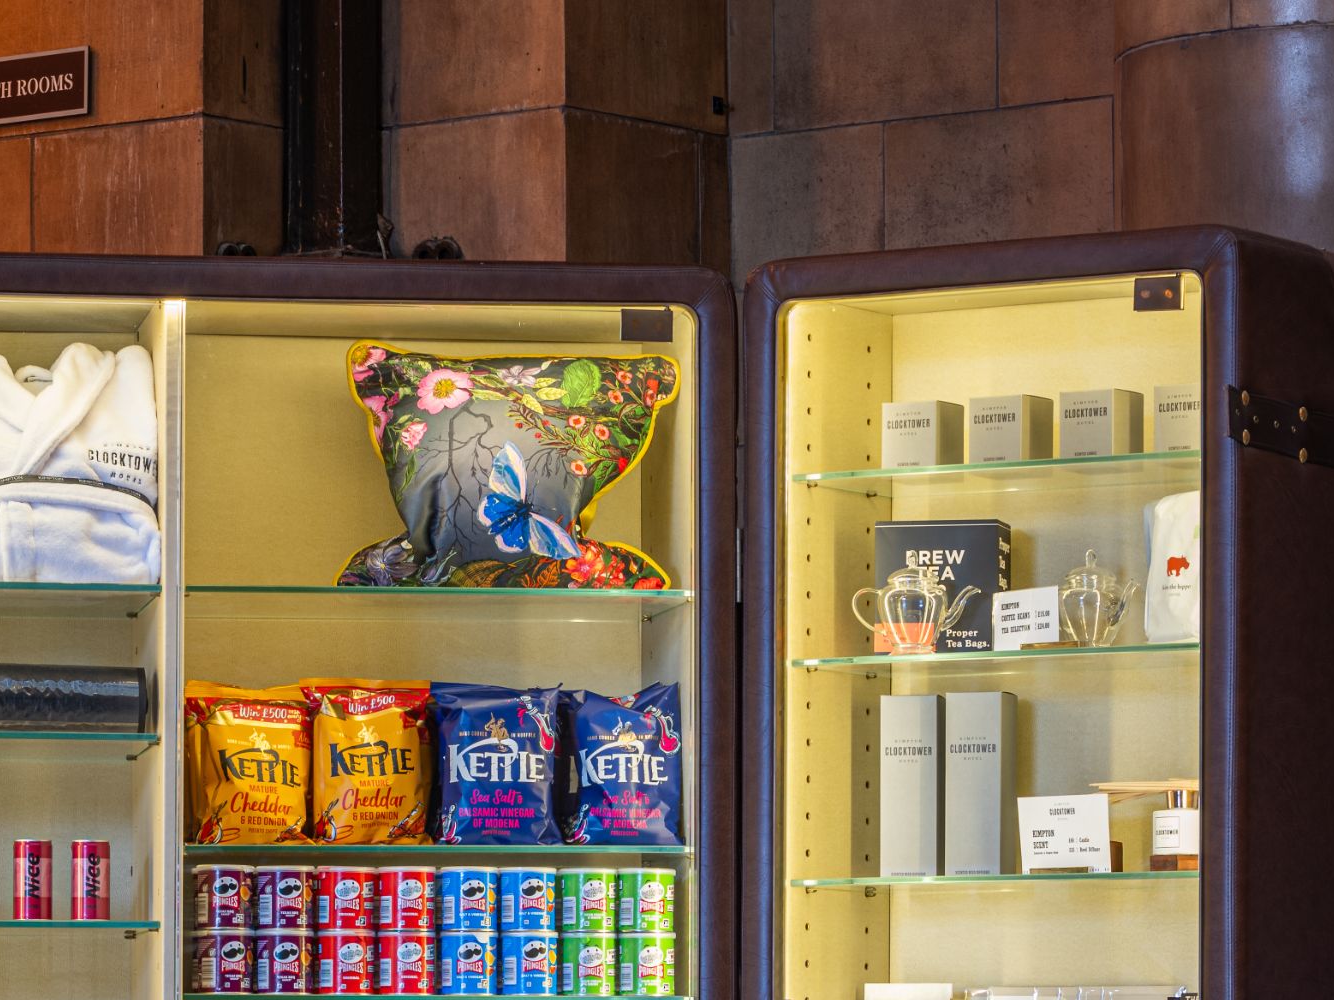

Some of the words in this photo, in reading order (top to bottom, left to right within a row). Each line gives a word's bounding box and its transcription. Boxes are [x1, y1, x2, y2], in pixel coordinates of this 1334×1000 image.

[17, 73, 74, 95] ROOMS
[973, 412, 1016, 425] CLOCKTOWER
[1064, 406, 1108, 419] CLOCKTOWER
[886, 418, 931, 430] CLOCKTOWER
[906, 549, 966, 565] BREW
[917, 566, 955, 581] TEA
[1001, 601, 1020, 611] KIMPTON
[1001, 613, 1016, 622] COFFEE
[1017, 612, 1031, 621] BEANS
[946, 629, 979, 639] Proper
[1010, 625, 1031, 633] SELECTION
[946, 639, 963, 648] Tea
[965, 639, 990, 650] Bags.
[348, 701, 369, 714] Win
[370, 695, 396, 709] £500
[239, 705, 261, 718] Win
[261, 708, 287, 719] £500
[885, 746, 933, 756] CLOCKTOWER
[950, 743, 997, 753] CLOCKTOWER
[329, 740, 415, 778] KETTLE
[448, 737, 545, 784] KETTLE
[578, 739, 669, 788] KETTLE
[218, 747, 301, 788] KETTLE
[249, 784, 278, 795] MATURE
[359, 779, 390, 788] MATURE
[341, 787, 407, 811] Cheddar
[470, 789, 490, 804] Sea
[492, 788, 515, 806] Salt
[602, 789, 618, 804] Sea
[230, 791, 293, 816] Cheddar
[359, 812, 374, 821] RED
[375, 811, 399, 821] ONION
[459, 807, 499, 818] BALSAMIC
[500, 807, 535, 818] VINEGAR
[590, 807, 627, 819] BALSAMIC
[628, 808, 662, 819] VINEGAR
[248, 816, 262, 825] RED
[263, 817, 287, 827] ONION
[473, 818, 483, 828] OF
[485, 818, 520, 829] MODENA
[602, 819, 612, 829] OF
[613, 818, 647, 829] MODENA
[1032, 830, 1055, 838] KIMPTON
[1033, 841, 1049, 849] SCENT
[212, 895, 238, 908] PRINGLES
[277, 897, 302, 909] PRINGLES
[335, 897, 360, 910] PRINGLES
[398, 897, 423, 910] PRINGLES
[460, 897, 486, 910] PRINGLES
[519, 897, 545, 909] PRINGLES
